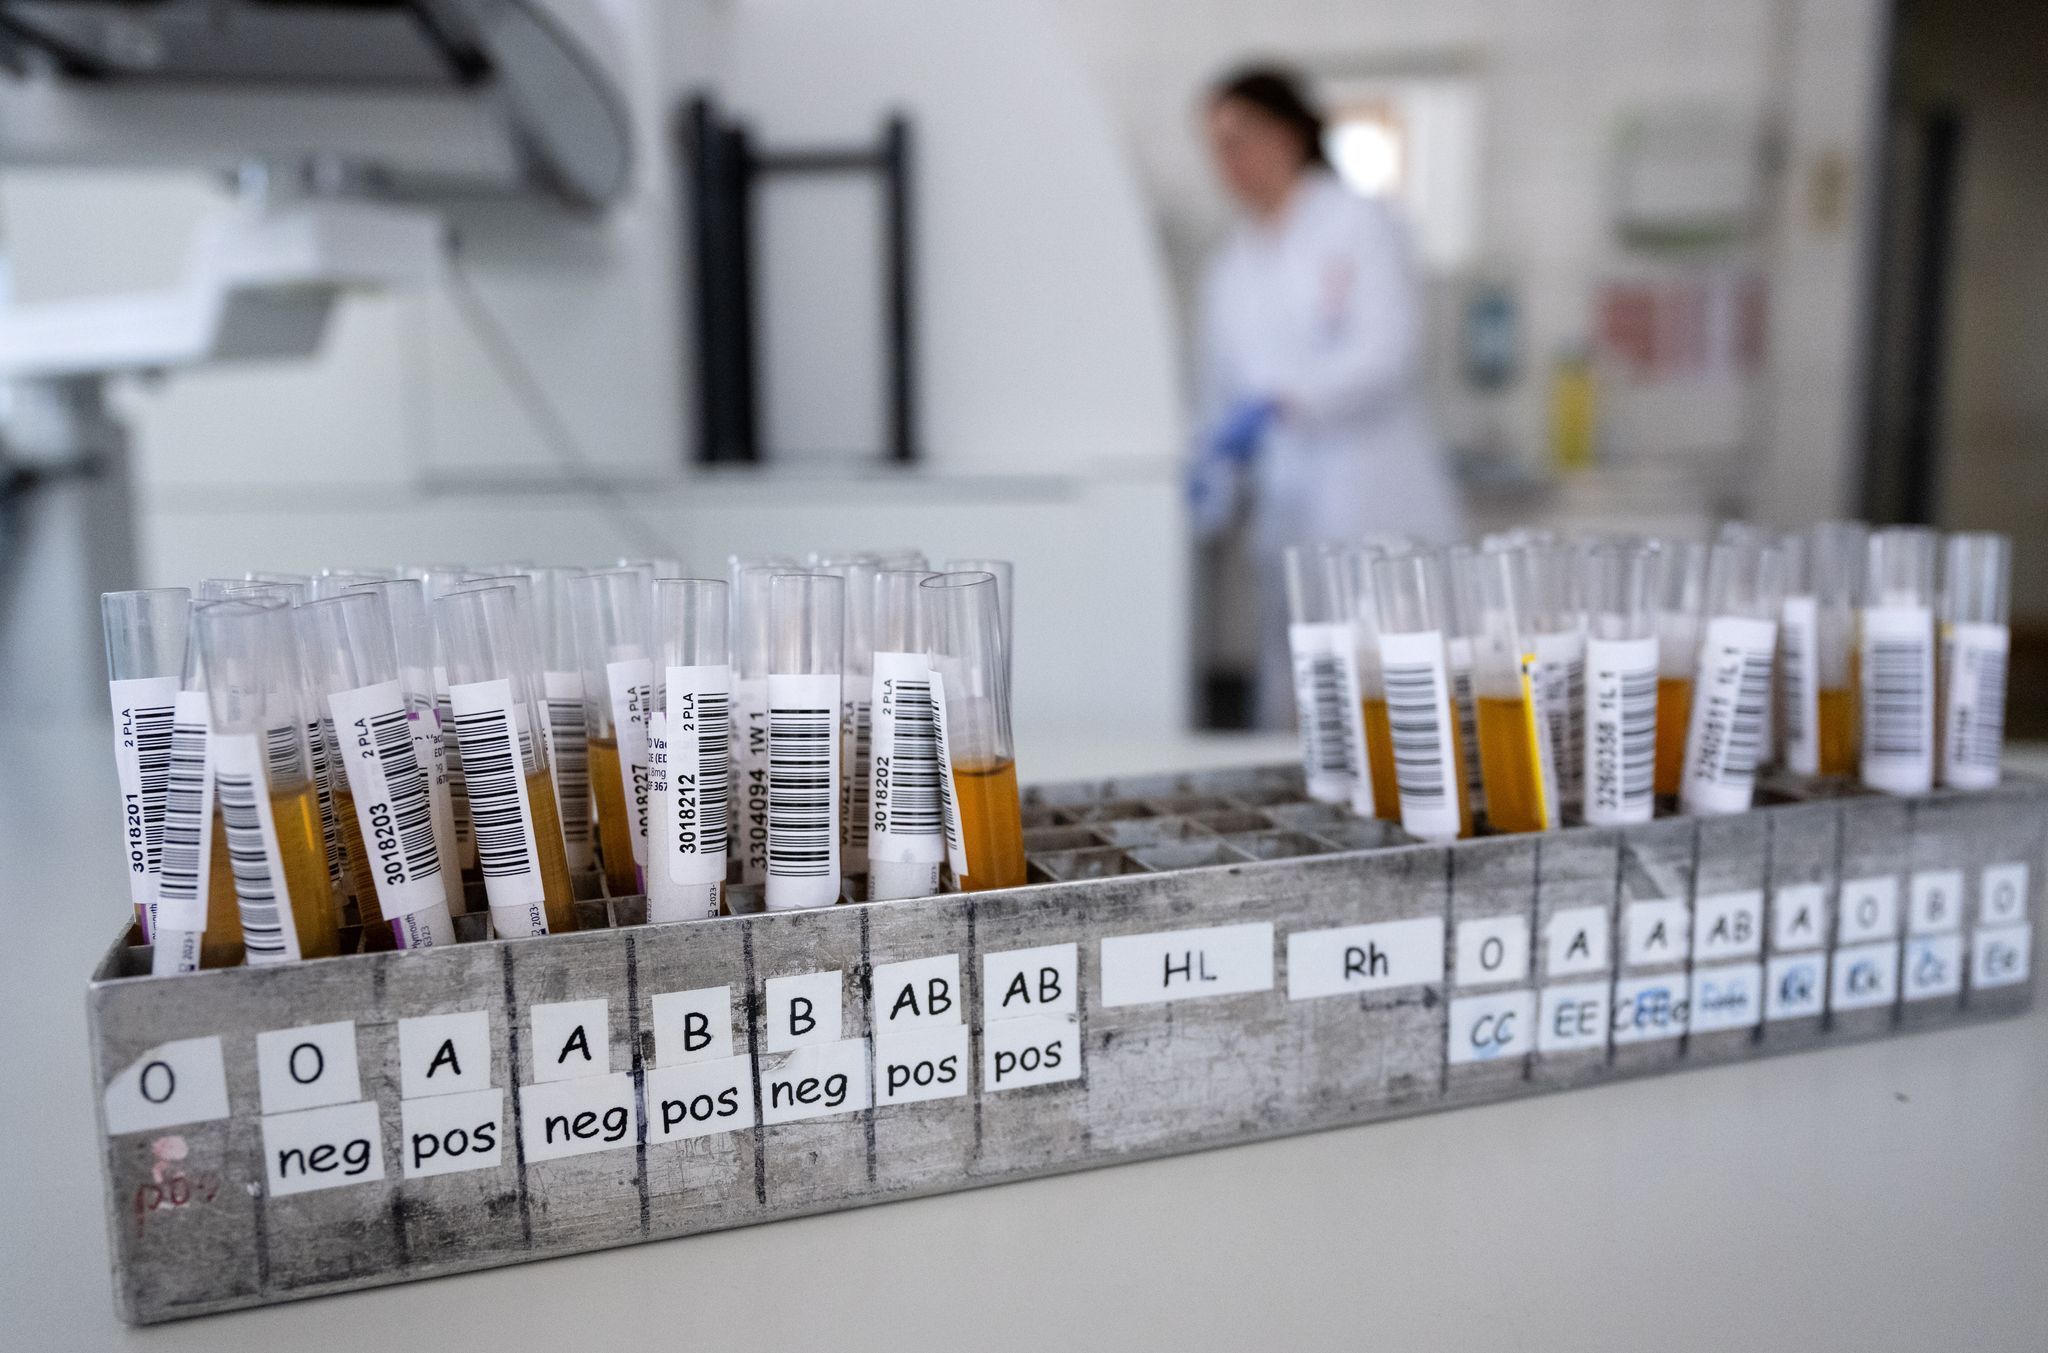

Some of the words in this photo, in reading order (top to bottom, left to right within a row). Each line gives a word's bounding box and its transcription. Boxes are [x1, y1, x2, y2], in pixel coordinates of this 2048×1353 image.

[626, 685, 640, 712] PLA
[682, 692, 694, 720] PLA
[882, 679, 893, 705] PLA
[121, 708, 133, 735] PLA
[683, 723, 695, 732] 2
[882, 707, 892, 716] 2
[124, 738, 134, 748] 2
[354, 717, 371, 748] PLA
[361, 749, 375, 760] 2
[874, 756, 890, 833] 3018202
[677, 774, 697, 854] 3018212
[749, 768, 768, 872] 3304094
[125, 793, 145, 874] 3018201
[368, 802, 407, 887] 3018203
[1707, 910, 1753, 945] AB
[1791, 904, 1812, 935] A
[1855, 894, 1880, 930] O
[1566, 928, 1590, 961] A
[1645, 918, 1668, 950] A
[1163, 951, 1217, 987] HL
[1344, 942, 1388, 979] Rh
[1479, 936, 1504, 972] O
[889, 977, 952, 1021] AB
[1003, 966, 1062, 1008] AB
[683, 1011, 712, 1052] B
[789, 996, 817, 1036] B
[1469, 1011, 1516, 1049] CC
[1553, 1001, 1598, 1038] EE
[426, 1038, 462, 1079] A
[557, 1024, 593, 1064] A
[994, 1040, 1063, 1082] pos
[140, 1061, 176, 1104] O
[289, 1042, 325, 1085] O
[887, 1054, 958, 1089] pos
[661, 1086, 739, 1134] pos
[771, 1072, 848, 1110] neg
[545, 1106, 629, 1145] neg
[278, 1138, 371, 1179] neg
[411, 1121, 496, 1170] pos
